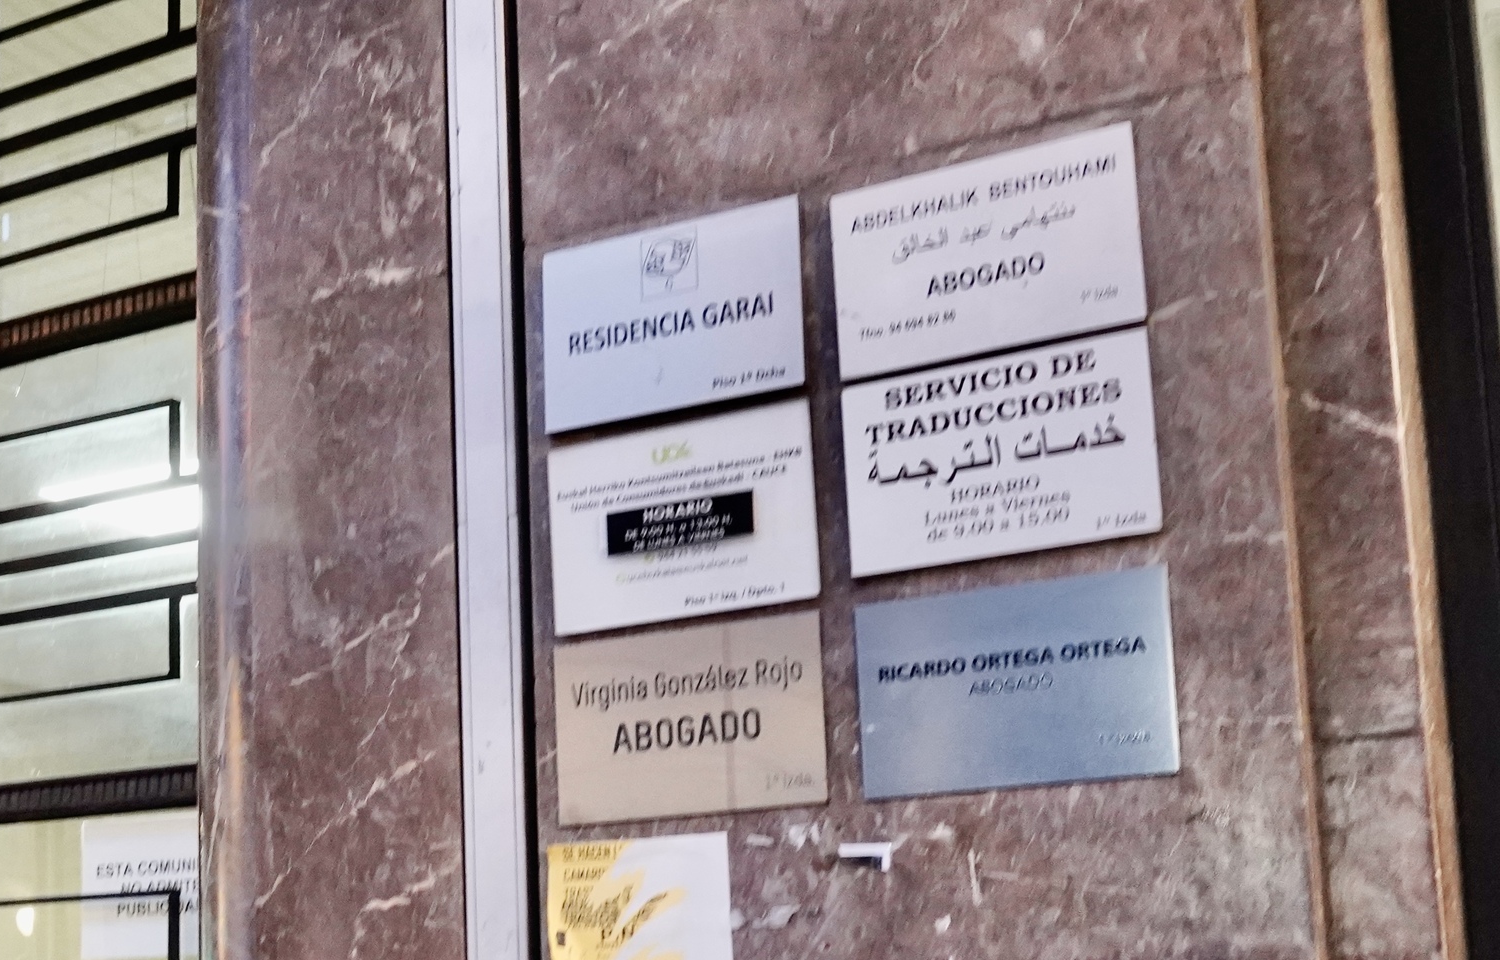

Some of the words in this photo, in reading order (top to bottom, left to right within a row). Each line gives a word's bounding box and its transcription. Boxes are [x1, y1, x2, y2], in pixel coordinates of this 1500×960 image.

[850, 187, 978, 236] ABDELKHALIK
[989, 153, 1117, 203] BENTOUHAMI
[926, 251, 1046, 299] ABOGADO
[568, 308, 696, 356] RESIDENCIA
[702, 290, 773, 328] GARAI
[885, 361, 1038, 410] SERVICIO
[1051, 348, 1097, 378] DE
[865, 377, 1122, 446] TRADUCCIONES
[924, 505, 980, 527] Lunes
[1002, 489, 1071, 512] Viernes
[951, 474, 1041, 503] HORARIO
[642, 498, 713, 524] HORARIO
[927, 527, 948, 543] de
[878, 656, 965, 684] RICARDO
[971, 645, 1054, 673] ORTEGA
[1060, 636, 1147, 662] ORTEGA
[571, 675, 648, 711] Virginia
[654, 664, 749, 699] González
[755, 655, 803, 691] Rojo
[968, 671, 1054, 696] ABOGADO
[613, 708, 762, 755] ABOGADO
[96, 861, 133, 878] ESTA
[137, 856, 199, 877] COMUNI
[120, 881, 142, 895] NO
[117, 897, 199, 917] PUBLICA
